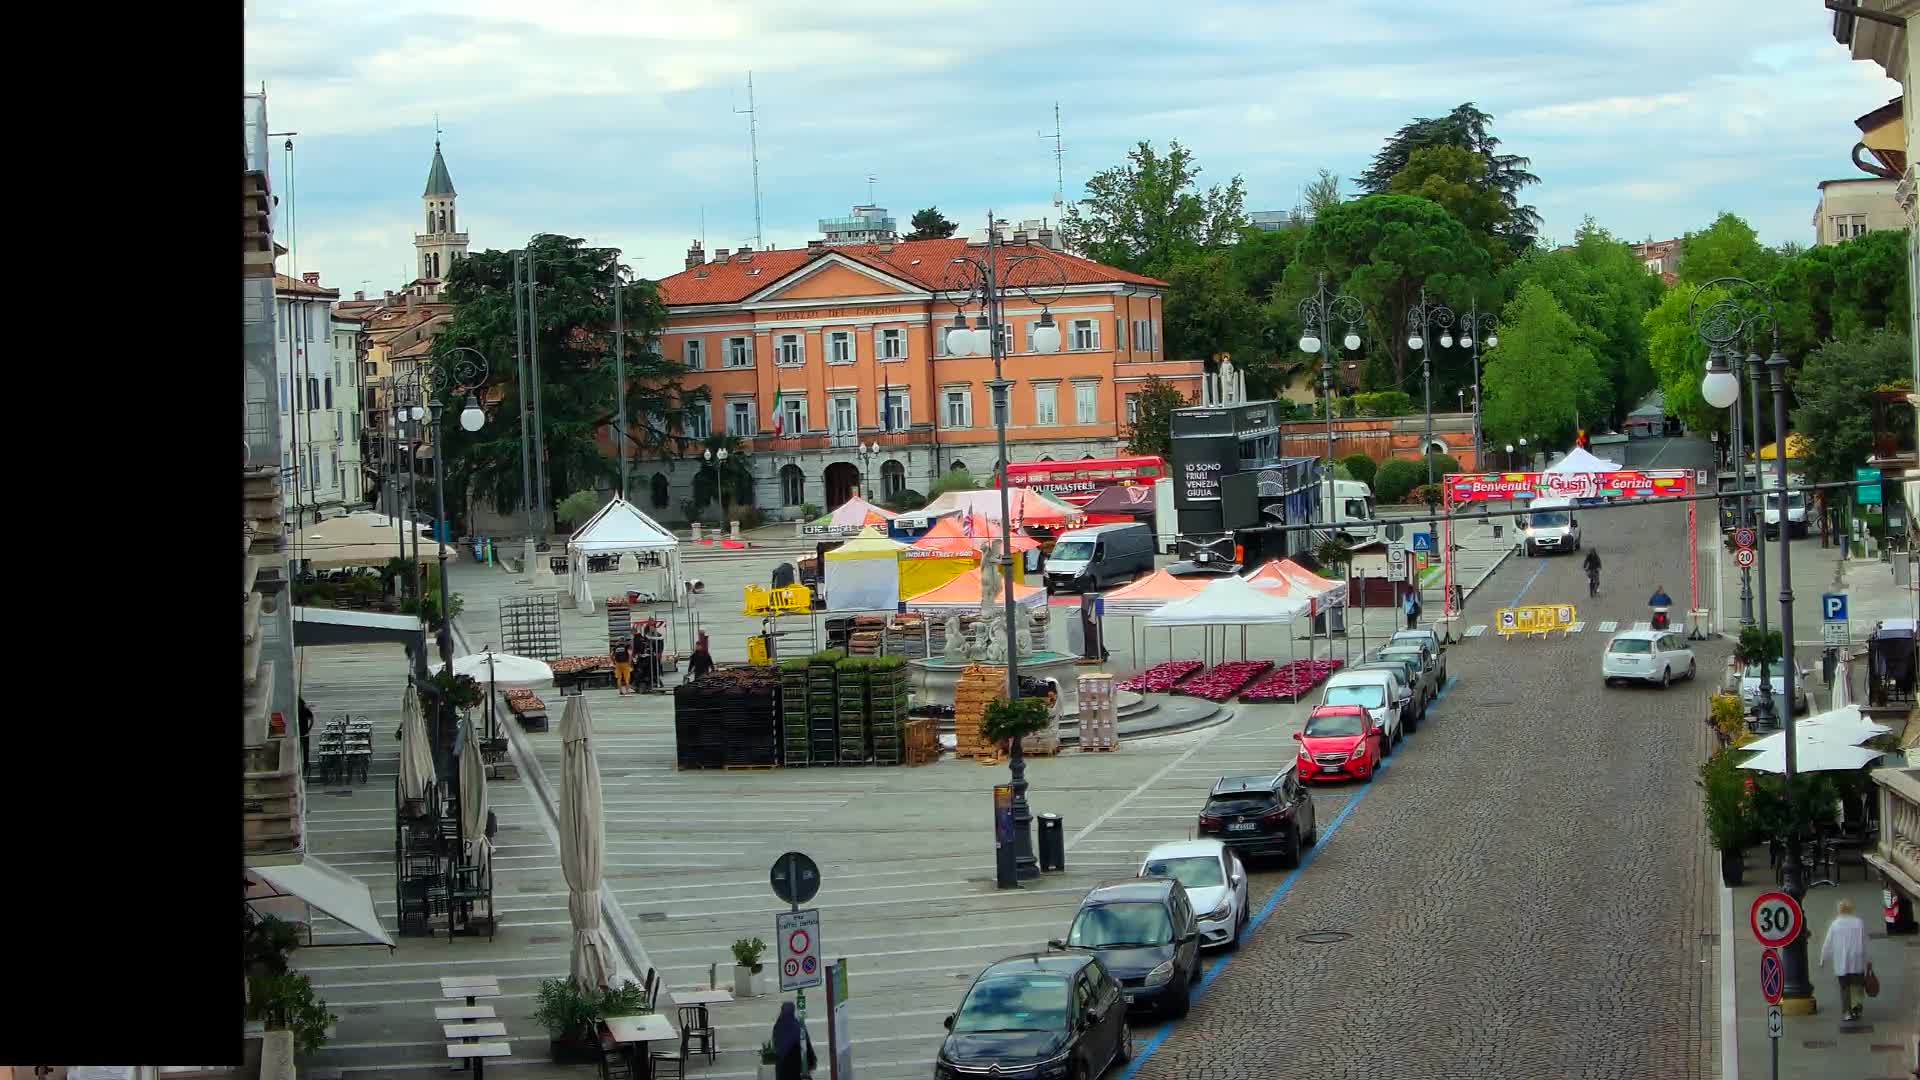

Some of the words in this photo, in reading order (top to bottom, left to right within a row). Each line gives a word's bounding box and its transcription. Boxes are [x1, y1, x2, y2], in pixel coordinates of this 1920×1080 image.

[828, 309, 848, 318] DEL
[856, 305, 901, 316] GOVERNO
[1185, 463, 1195, 472] IO
[1196, 463, 1221, 472] SONO
[1186, 472, 1208, 480] FRIULI
[1186, 480, 1219, 488] VENEZIA
[1473, 479, 1532, 492] Benvenuti
[1550, 476, 1587, 490] Gusti
[1612, 477, 1653, 489] Gorizia
[1187, 489, 1213, 497] GIULIA
[1740, 553, 1751, 562] 20
[1828, 598, 1842, 618] P
[1760, 907, 1789, 932] 30
